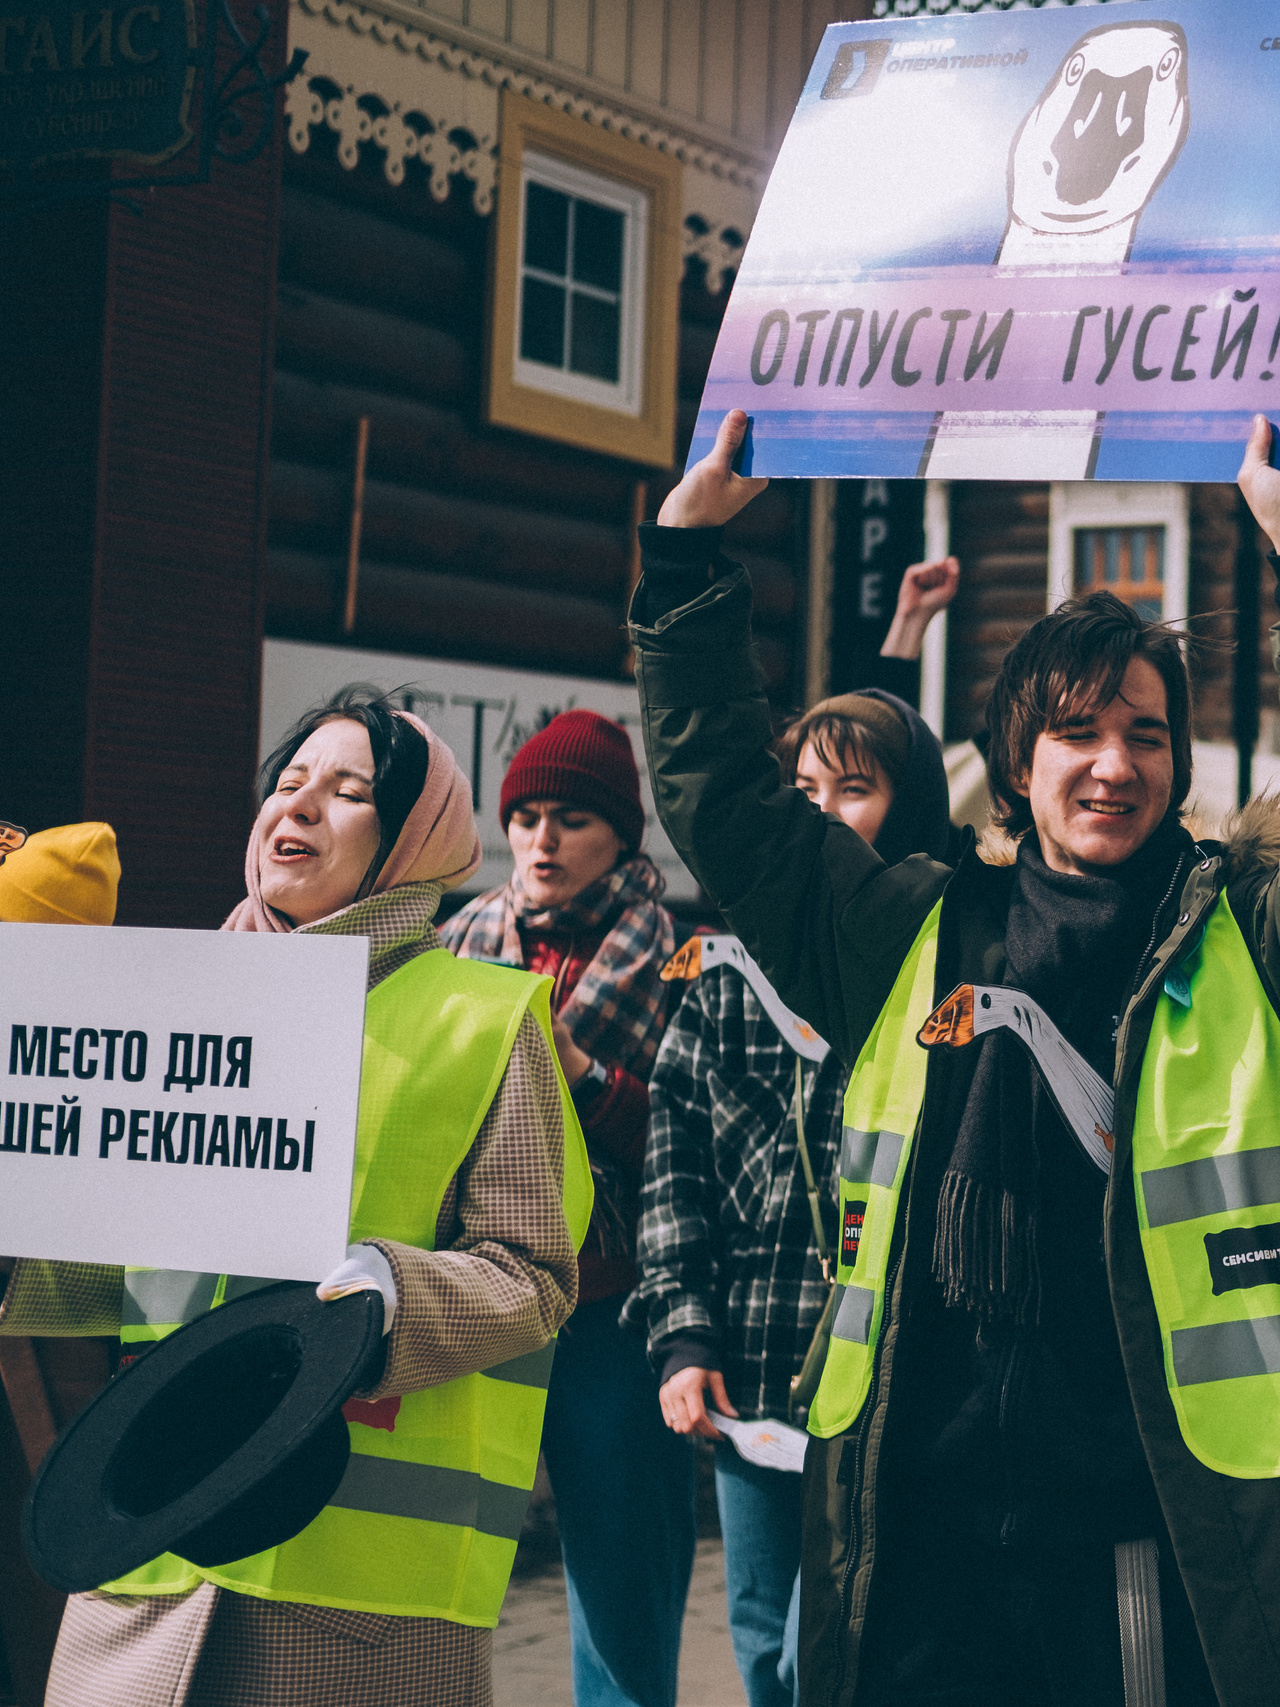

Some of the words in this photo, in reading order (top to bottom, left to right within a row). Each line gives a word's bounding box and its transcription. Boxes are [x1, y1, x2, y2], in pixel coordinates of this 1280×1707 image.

[887, 48, 1029, 73] ОПЕРАТИВНОЙ
[891, 38, 956, 57] ЦЕНТР
[750, 306, 1014, 388] ОТПУСТИ
[8, 1024, 148, 1083] МЕСТО
[163, 1032, 253, 1093] ДЛЯ
[98, 1107, 316, 1173] РЕКЛАМЫ
